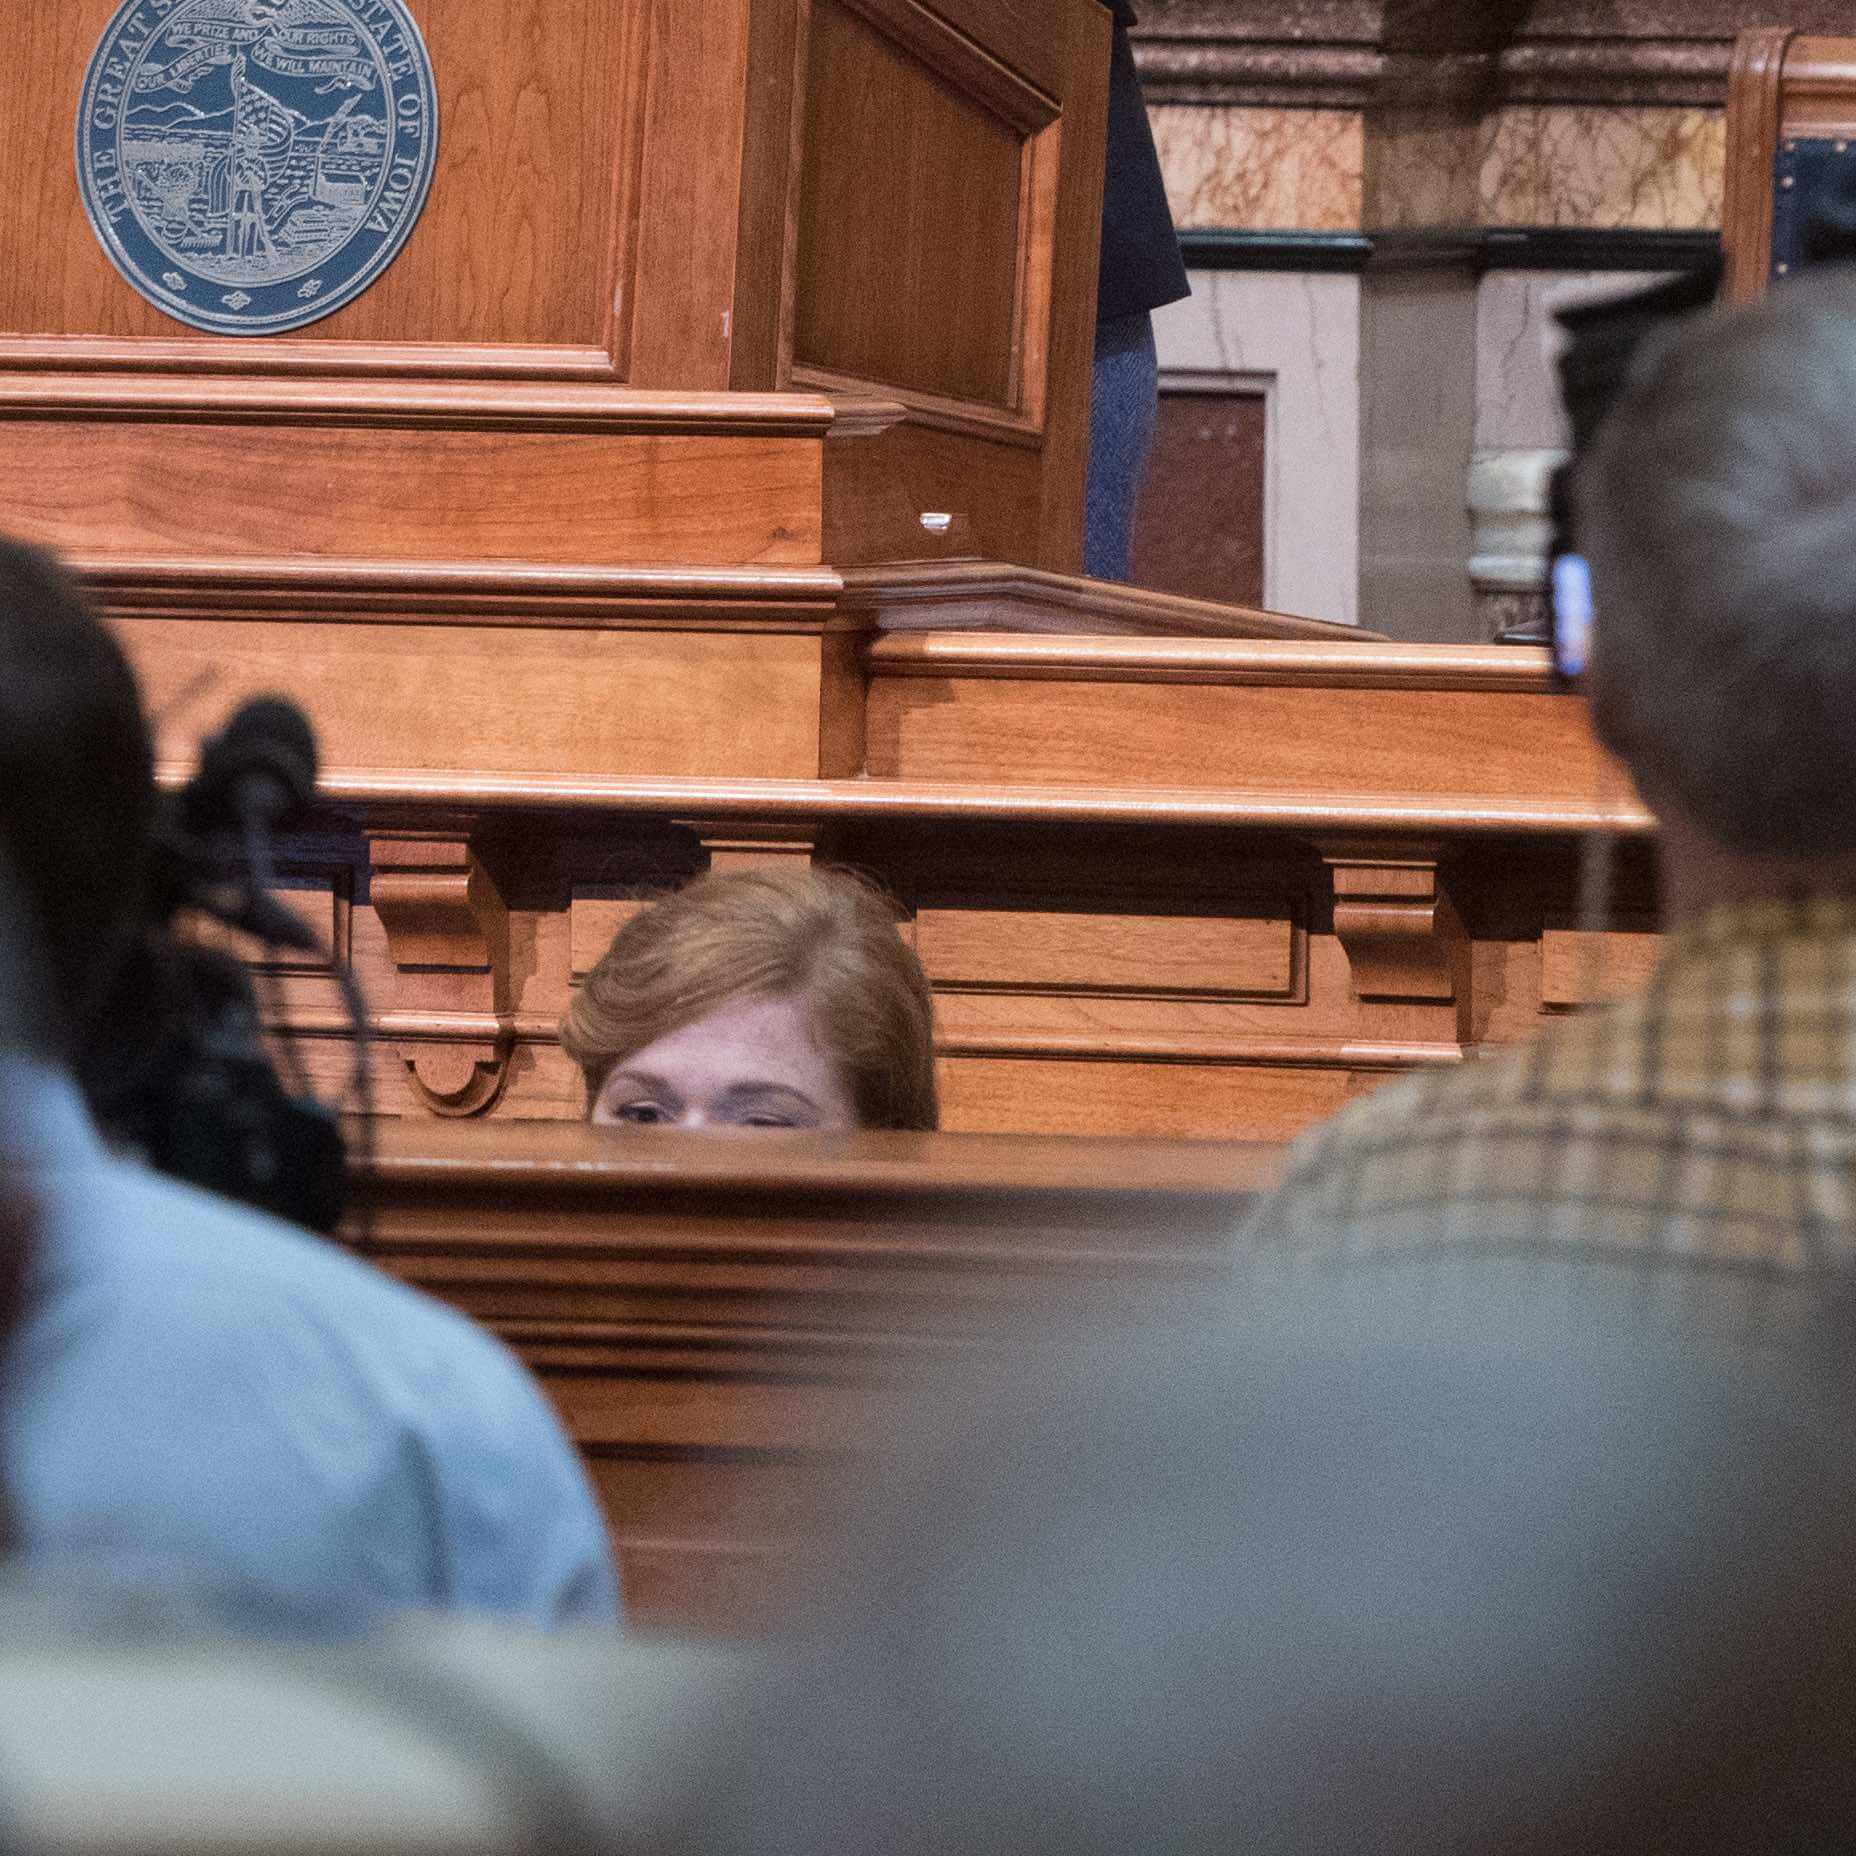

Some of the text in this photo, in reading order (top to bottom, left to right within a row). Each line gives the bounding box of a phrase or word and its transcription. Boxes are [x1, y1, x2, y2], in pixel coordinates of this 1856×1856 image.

[171, 22, 260, 42] WE PRIZE AND
[279, 29, 304, 43] OUR
[94, 13, 153, 130] GREAT
[169, 46, 229, 78] LIBERTIES
[253, 46, 373, 79] WE WILL MAINTAIN
[397, 93, 421, 139] OF
[95, 149, 129, 224] THE
[364, 153, 419, 233] IOWA
